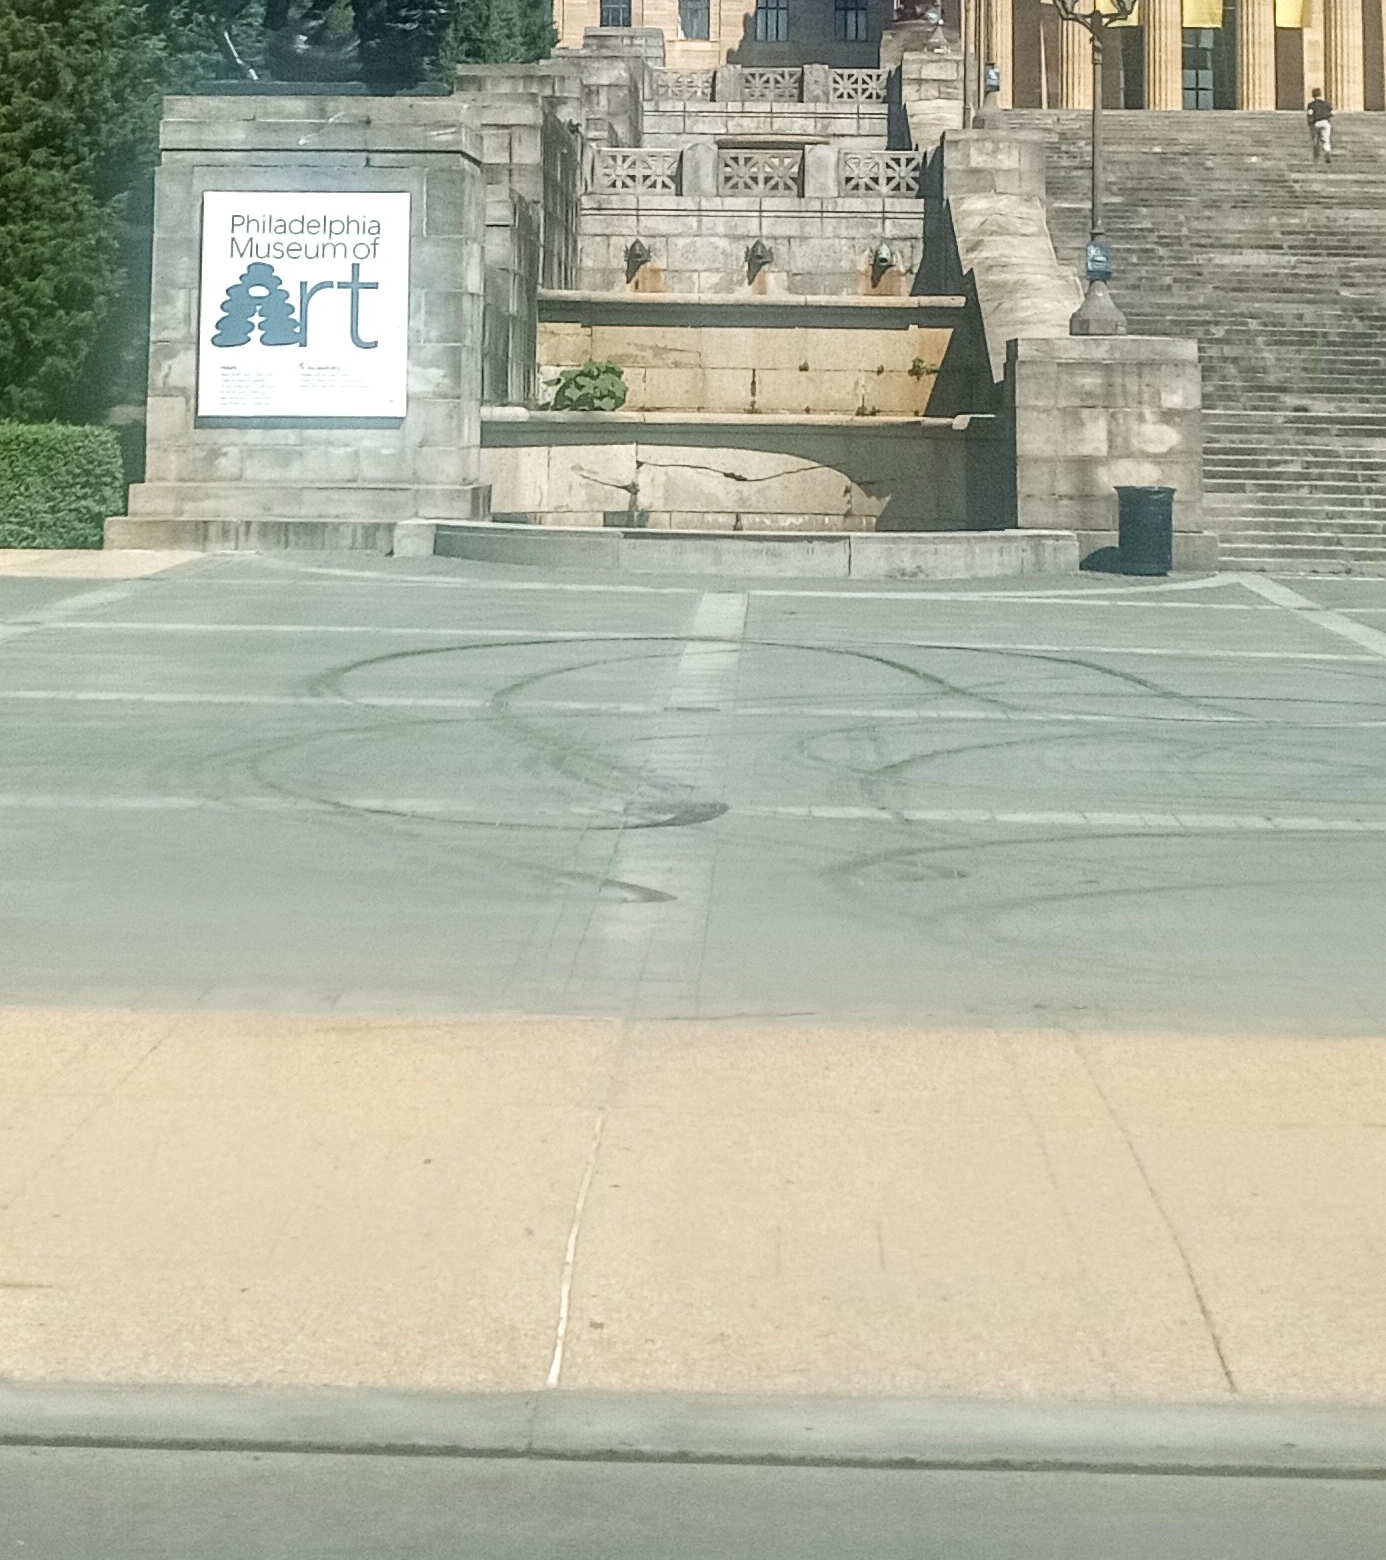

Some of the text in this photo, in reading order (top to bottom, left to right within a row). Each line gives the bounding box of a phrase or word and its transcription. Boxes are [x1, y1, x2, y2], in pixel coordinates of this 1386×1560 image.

[230, 214, 381, 240] Philadelphia
[230, 237, 380, 260] Museum of
[210, 261, 379, 349] Art
